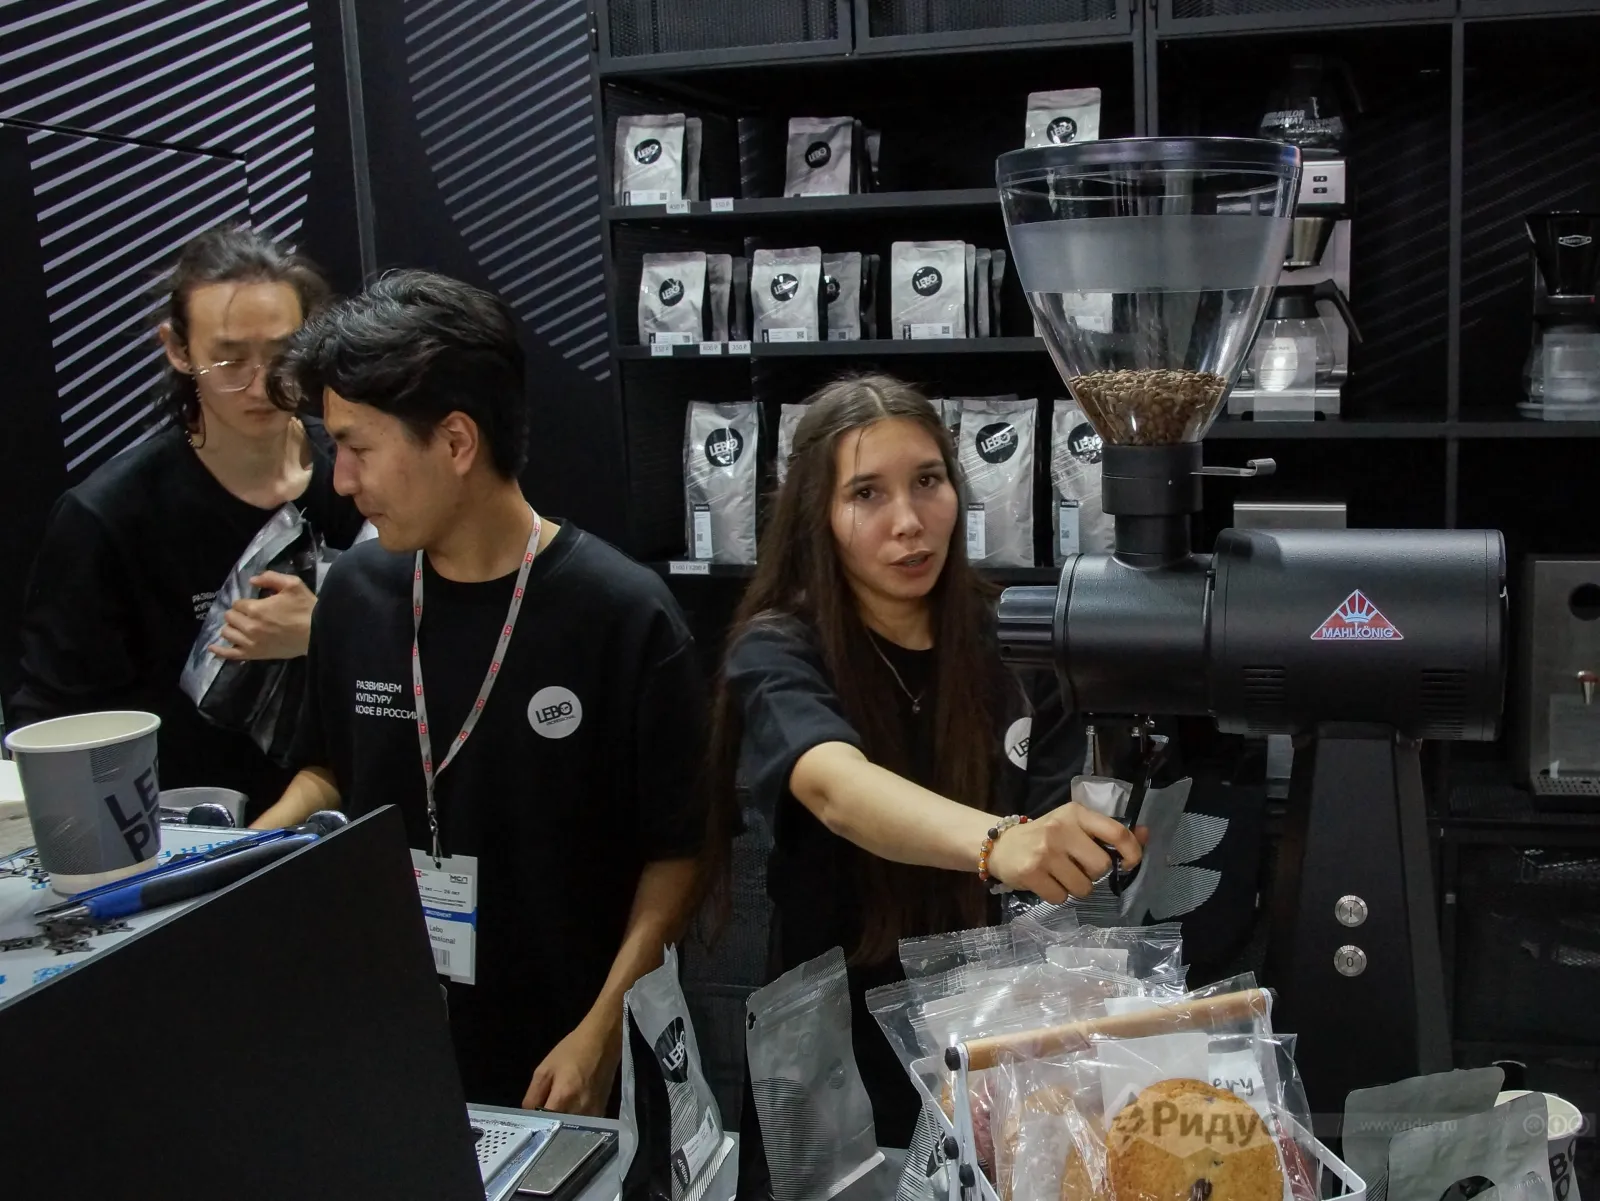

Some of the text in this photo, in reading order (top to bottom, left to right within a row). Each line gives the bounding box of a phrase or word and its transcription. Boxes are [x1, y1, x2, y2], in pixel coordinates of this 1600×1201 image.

[808, 147, 827, 162] LEBO
[916, 273, 938, 290] LEBO
[662, 285, 680, 300] LEBO
[709, 438, 738, 457] LEBO
[980, 432, 1011, 453] LEBO
[1322, 626, 1394, 638] MAHLKÖNIG
[356, 680, 402, 693] РАЗВИВАЕМ
[356, 692, 392, 705] КУЛЬТУРУ
[355, 705, 375, 716] КОФЕ
[376, 707, 382, 716] В
[535, 701, 573, 724] LEBO
[1013, 737, 1030, 758] LE
